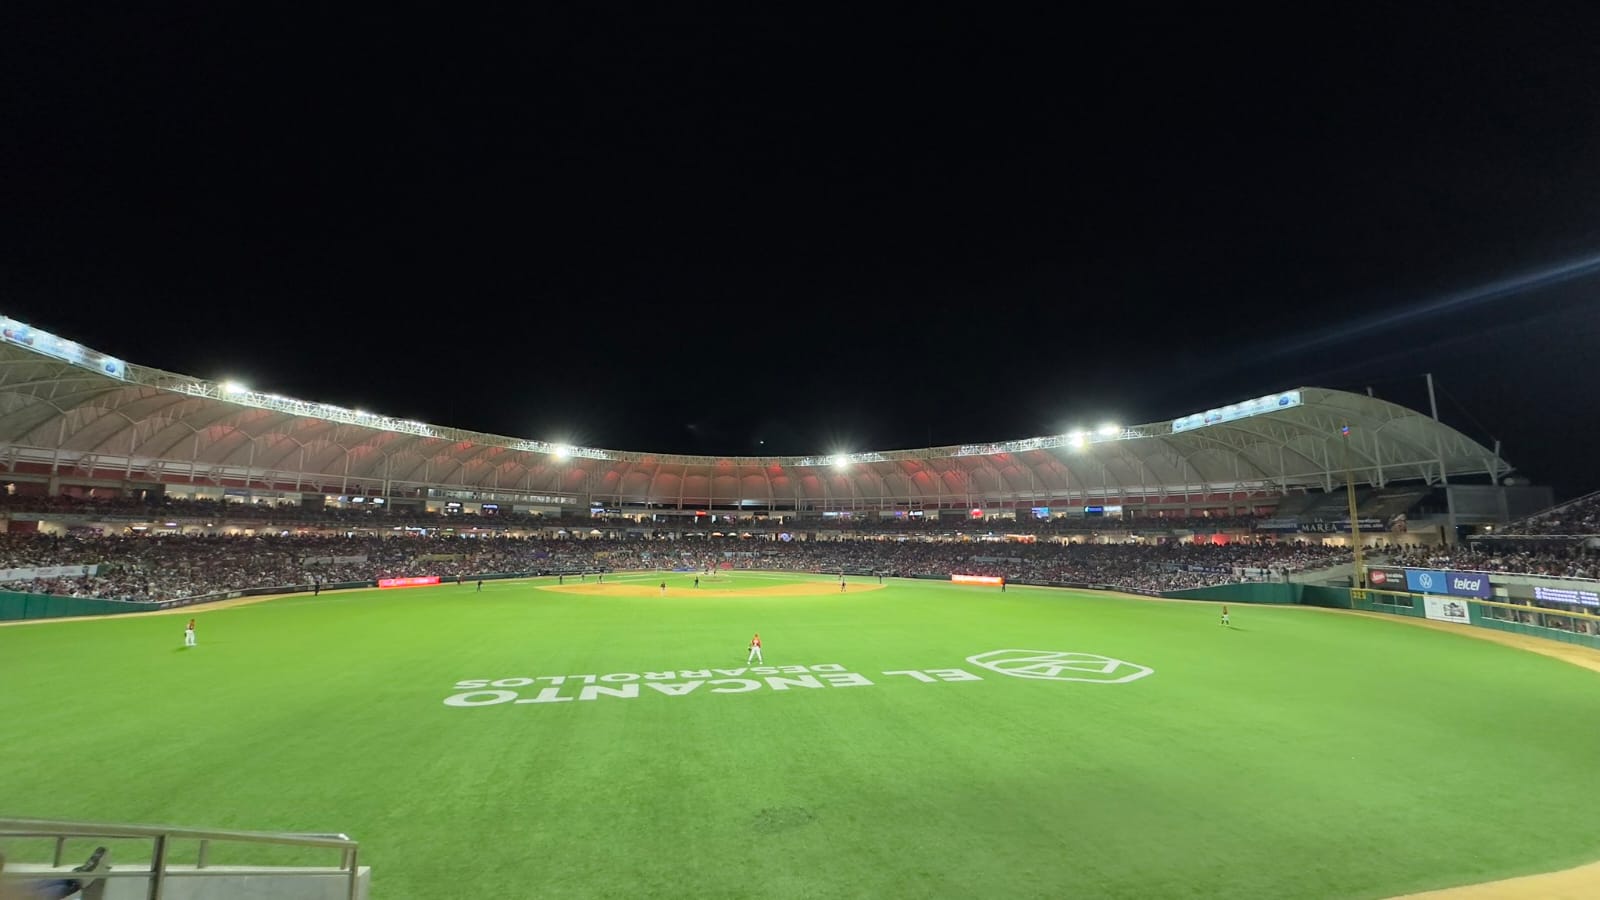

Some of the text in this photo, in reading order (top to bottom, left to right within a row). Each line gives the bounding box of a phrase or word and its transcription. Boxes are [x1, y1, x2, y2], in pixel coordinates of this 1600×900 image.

[1301, 522, 1338, 533] MAREA
[1453, 577, 1481, 591] telcel
[453, 663, 847, 689] DESARROLLOS
[442, 668, 984, 707] EL ENCANTO
